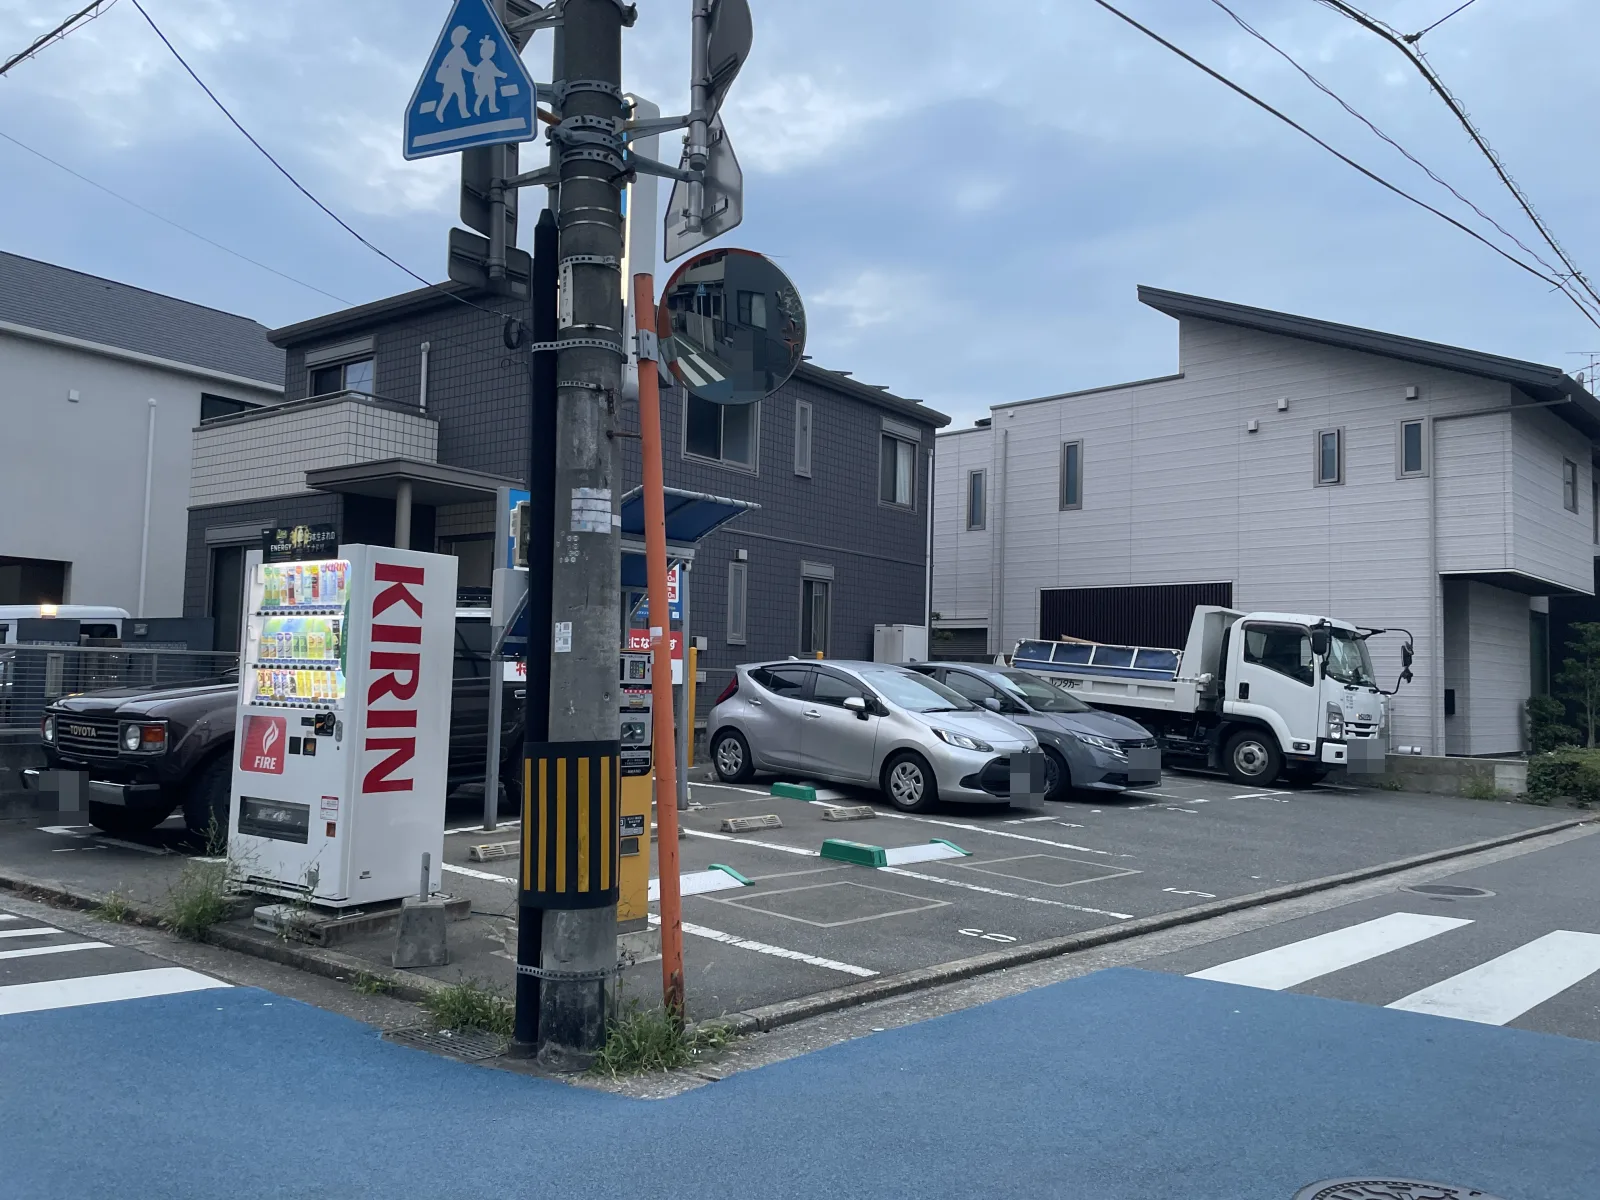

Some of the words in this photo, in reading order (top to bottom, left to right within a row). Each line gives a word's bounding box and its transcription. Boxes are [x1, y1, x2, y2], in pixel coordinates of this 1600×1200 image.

[270, 543, 292, 552] ENERGY
[325, 562, 349, 572] KIRIN
[362, 562, 425, 794] KIRIN
[70, 725, 97, 737] TOYOTA
[253, 755, 277, 770] FIRE
